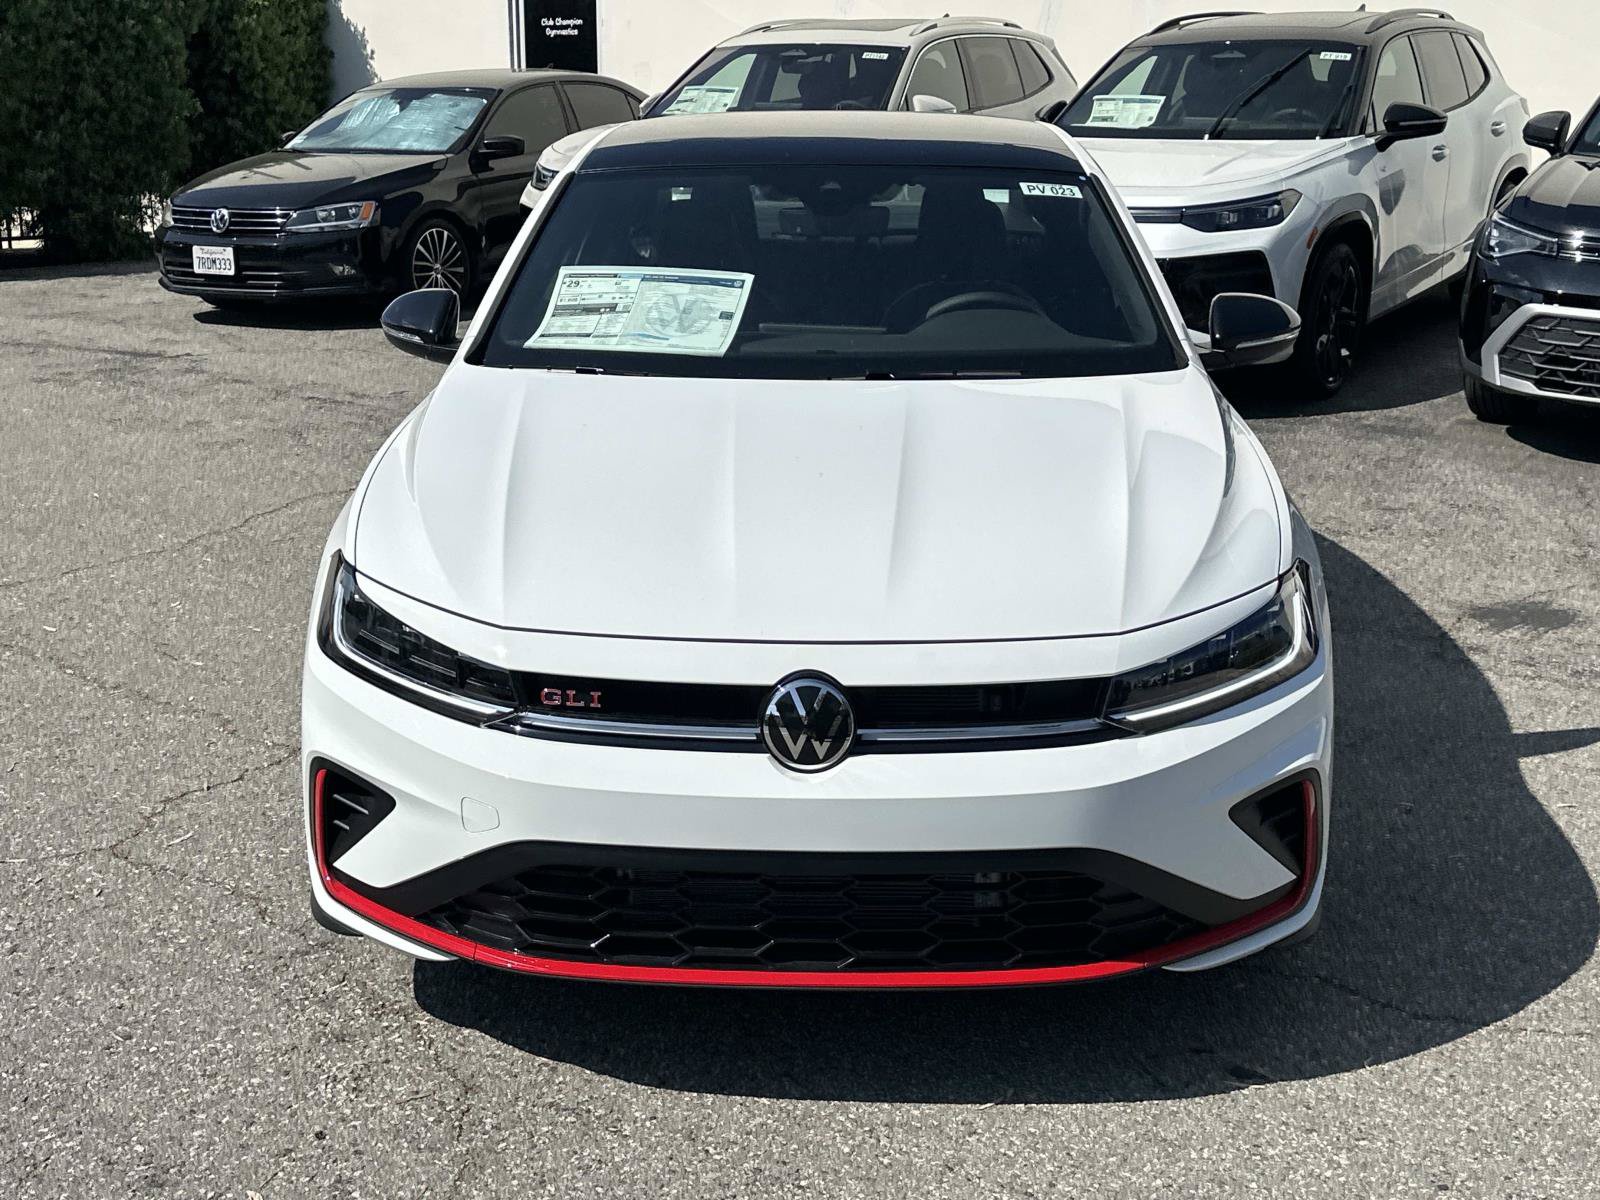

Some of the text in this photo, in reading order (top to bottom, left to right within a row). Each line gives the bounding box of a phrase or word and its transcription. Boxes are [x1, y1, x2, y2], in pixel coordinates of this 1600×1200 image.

[541, 17, 583, 27] Club Champion
[546, 28, 578, 37] Gymnastics
[1026, 184, 1076, 196] PV 023
[196, 256, 232, 271] 7RDM333
[566, 280, 580, 288] 29
[540, 687, 602, 708] GLI
